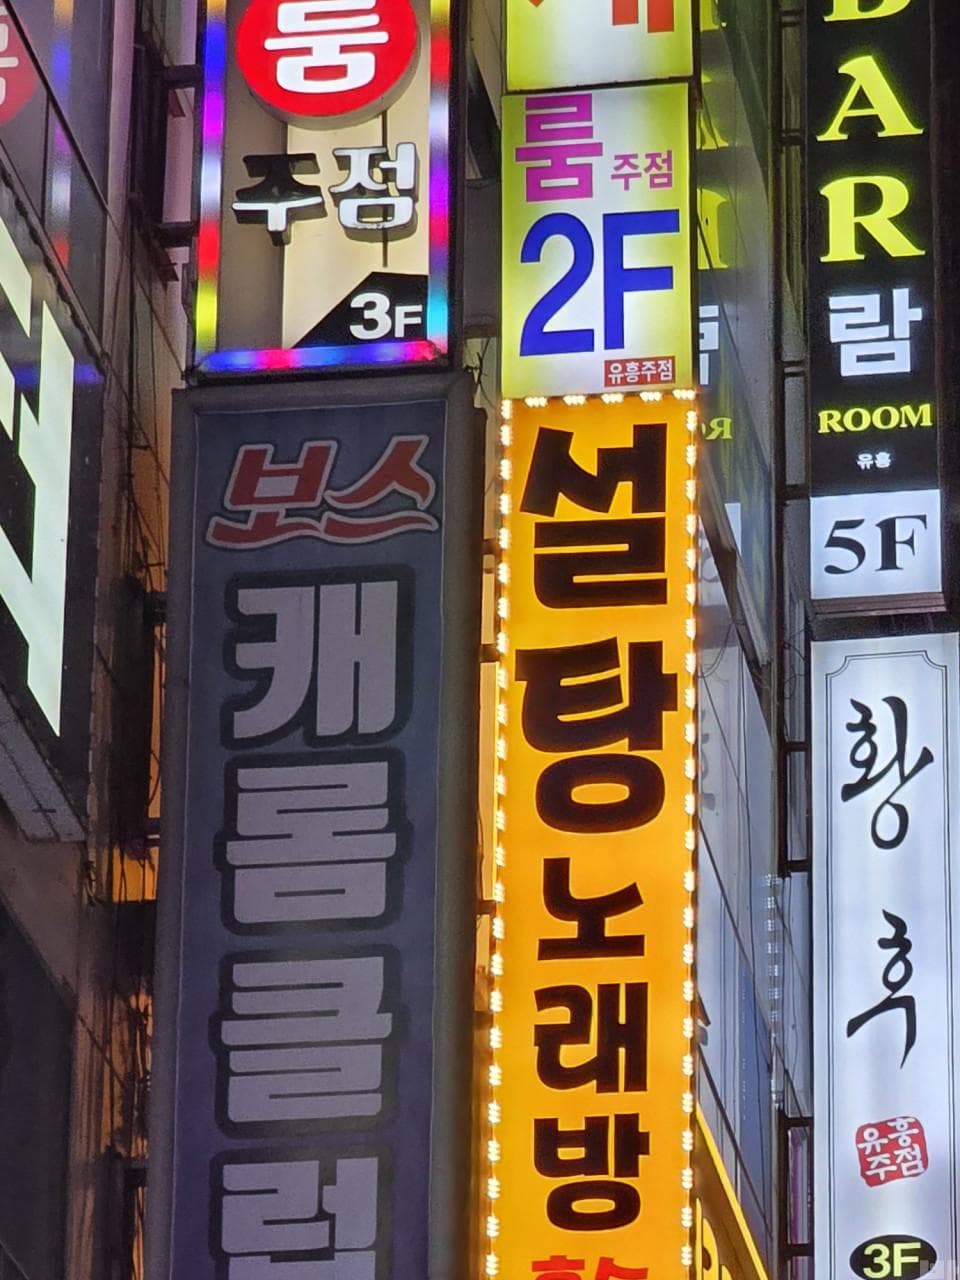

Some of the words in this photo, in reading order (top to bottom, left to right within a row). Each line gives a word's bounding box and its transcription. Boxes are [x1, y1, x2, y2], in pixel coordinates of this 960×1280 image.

[515, 94, 603, 202] 룸
[610, 150, 674, 191] 주점
[817, 0, 925, 262] AR
[232, 142, 417, 233] 주점
[349, 292, 422, 340] 3F
[520, 208, 680, 357] 2F
[608, 360, 673, 385] 유흥주점
[828, 288, 923, 377] 람
[817, 403, 933, 434] ROOM
[855, 451, 892, 470] 유흥
[205, 434, 438, 550] 보스
[823, 513, 928, 576] 5F
[840, 696, 934, 1070] 황후
[863, 1242, 922, 1279] 3F
